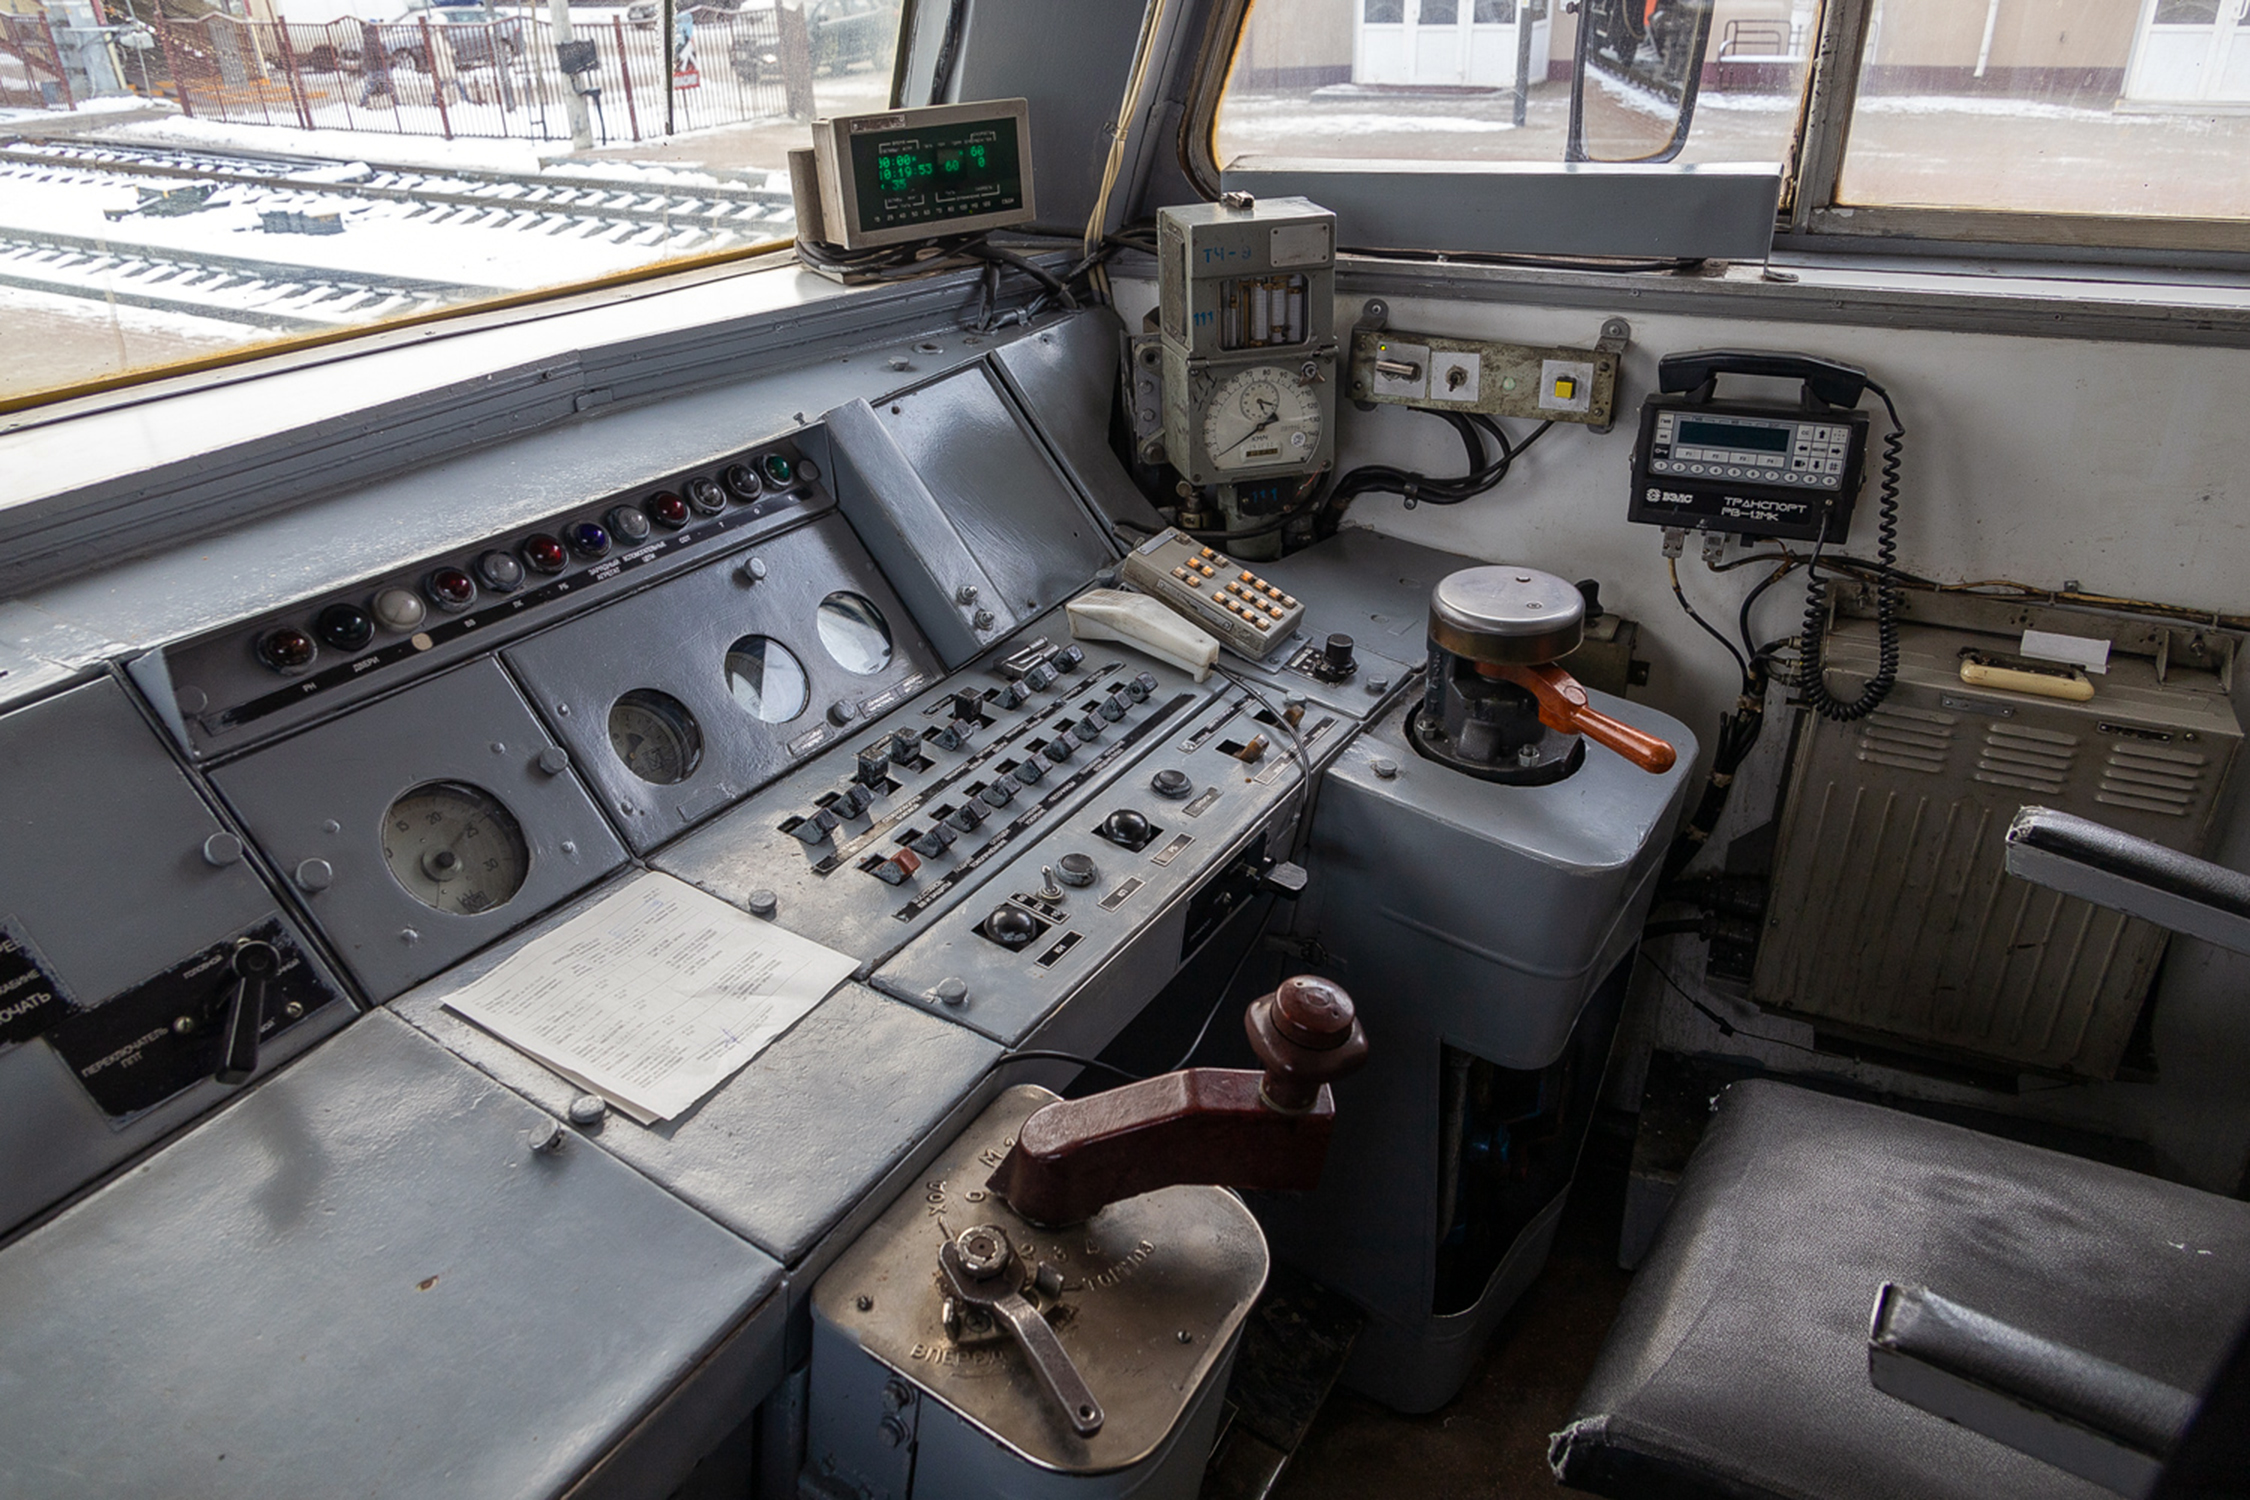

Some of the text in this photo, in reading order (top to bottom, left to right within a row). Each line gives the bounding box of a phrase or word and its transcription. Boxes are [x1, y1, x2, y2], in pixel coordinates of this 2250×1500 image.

[970, 145, 985, 157] 60
[1724, 496, 1808, 514] ТРАНСПОРТ
[352, 656, 381, 673] ДВЕРИ
[425, 811, 443, 826] 20
[482, 858, 499, 873] 30
[81, 1027, 169, 1078] ПЕРЕКЛЮЧАТЕЛЬ
[120, 1050, 143, 1069] ППТ
